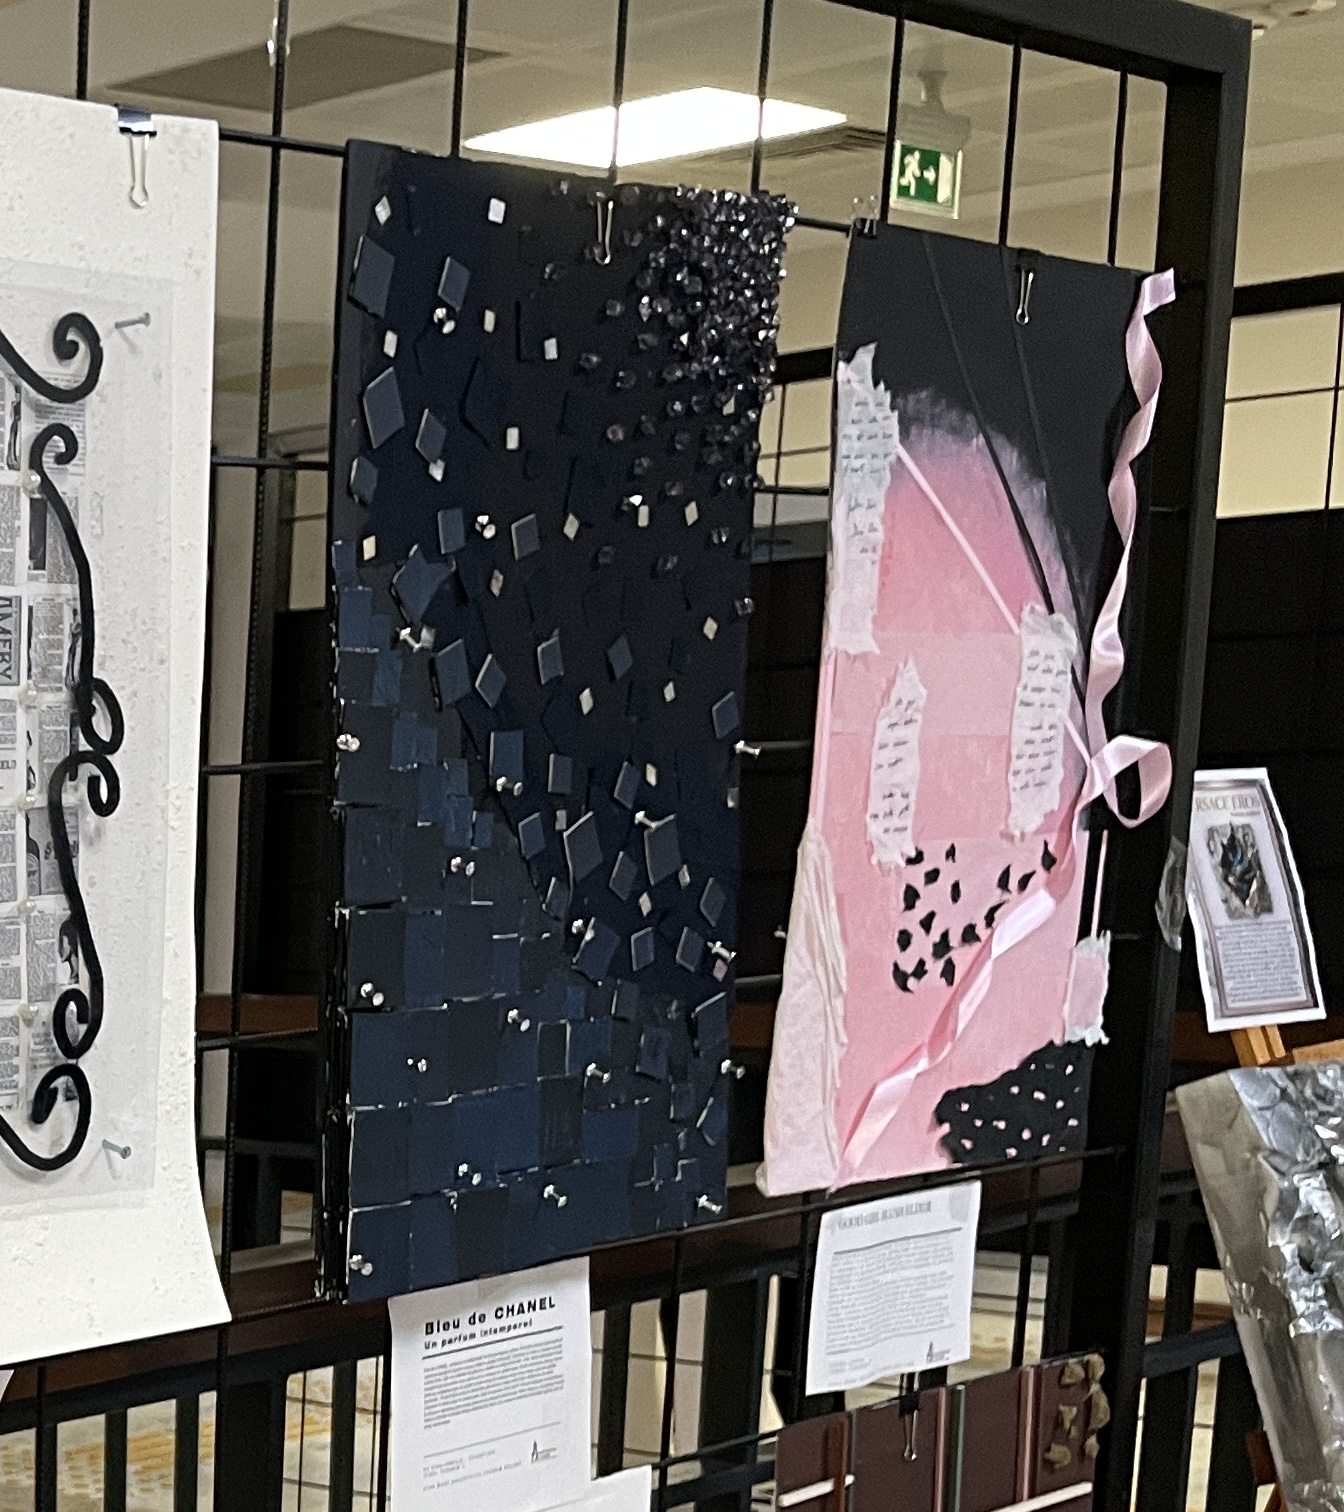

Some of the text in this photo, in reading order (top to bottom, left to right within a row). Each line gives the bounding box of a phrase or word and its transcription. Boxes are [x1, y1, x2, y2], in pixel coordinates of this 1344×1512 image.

[425, 1295, 556, 1336] Bleu de CHANEL
[424, 1339, 438, 1350] Un
